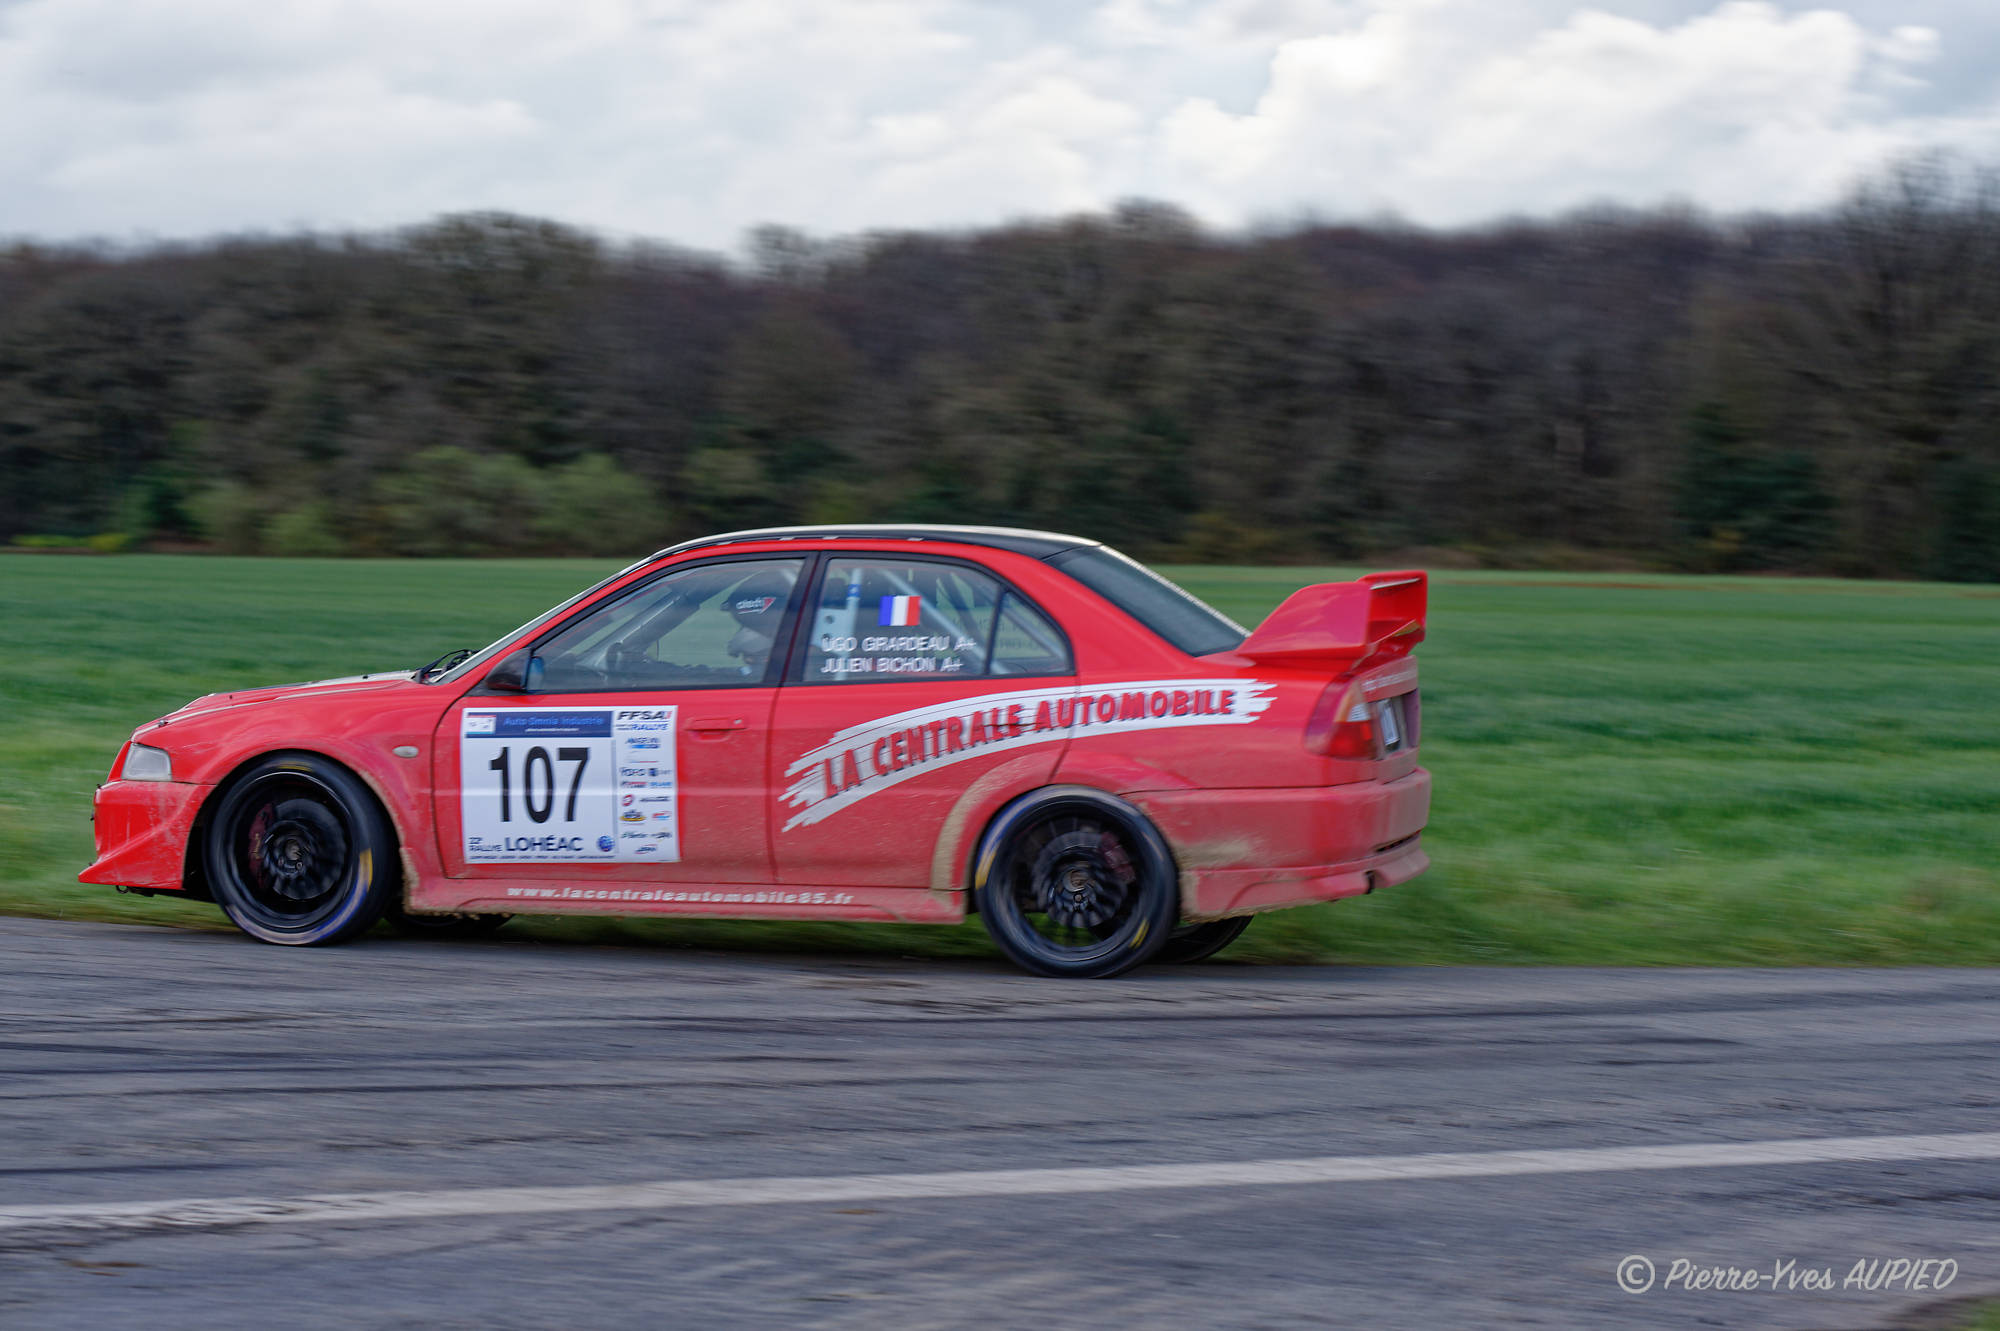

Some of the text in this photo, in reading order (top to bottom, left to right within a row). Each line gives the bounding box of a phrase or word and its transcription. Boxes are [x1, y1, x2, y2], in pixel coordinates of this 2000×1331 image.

[877, 657, 936, 673] BICHON
[617, 710, 668, 720] FFSA
[824, 689, 1235, 798] LA CENTRALE AUTOMOBILE
[489, 746, 590, 824] 107
[504, 834, 584, 852] LOHÉAC
